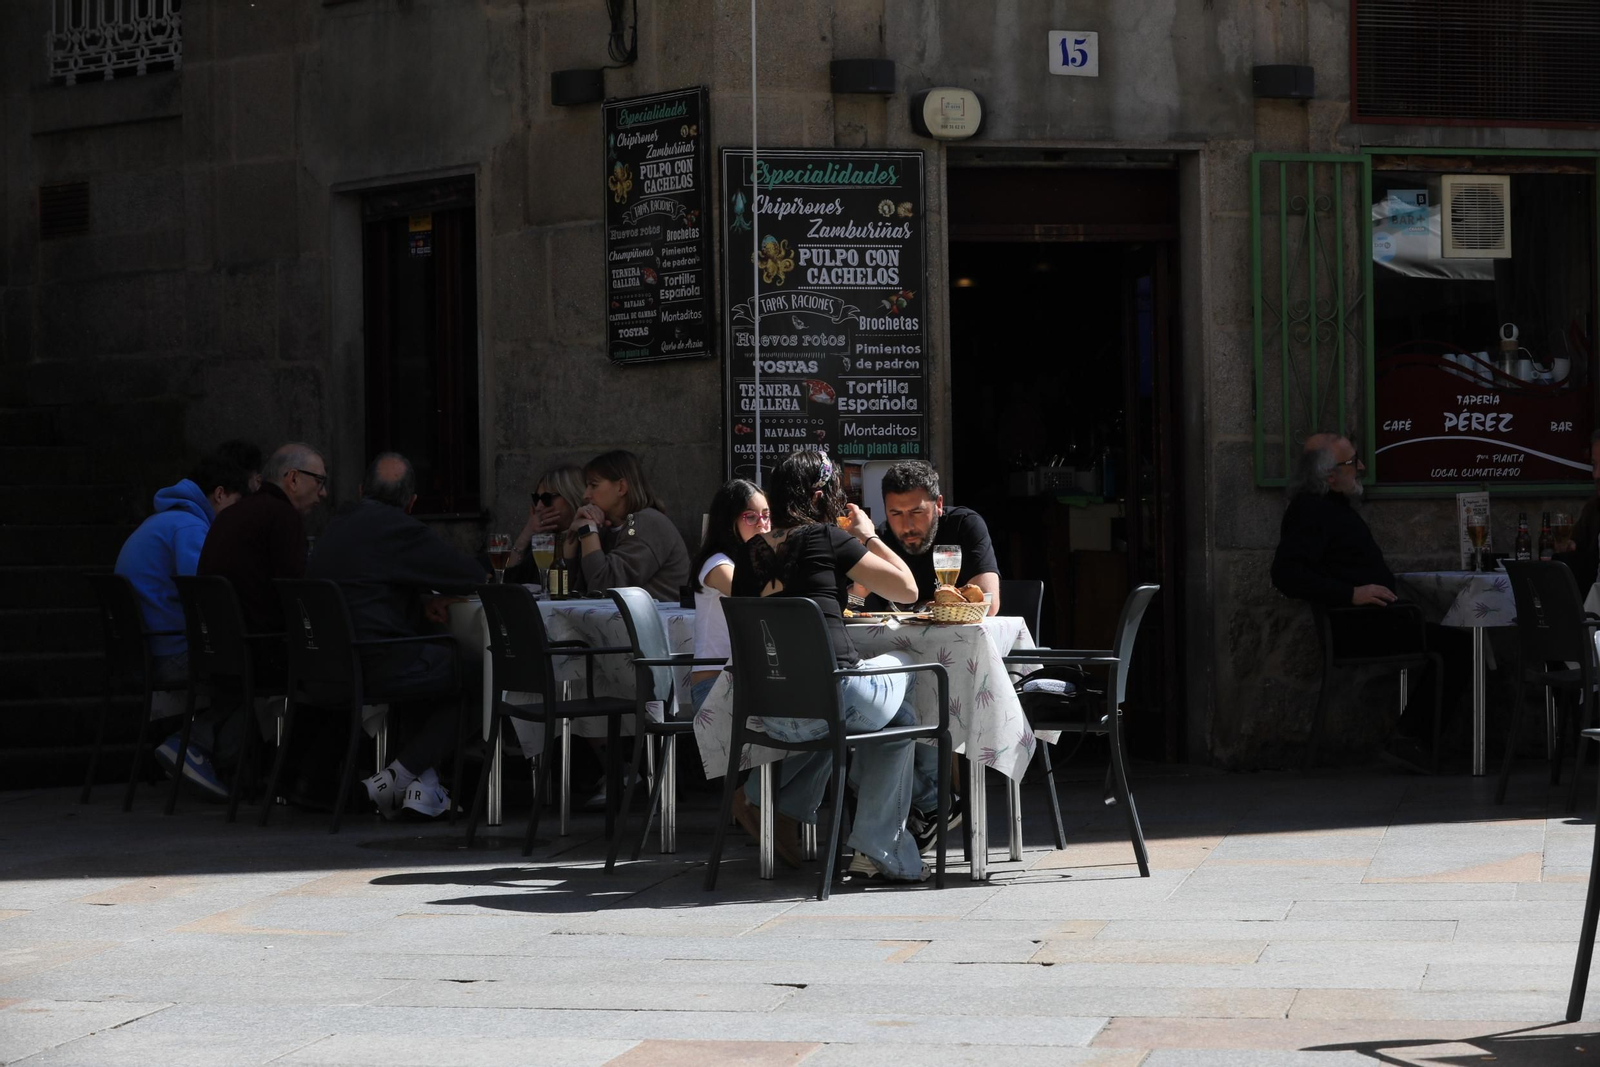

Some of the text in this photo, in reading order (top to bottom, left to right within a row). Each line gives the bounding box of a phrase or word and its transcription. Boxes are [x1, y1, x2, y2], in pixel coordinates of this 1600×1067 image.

[1059, 38, 1088, 67] 15
[619, 101, 688, 129] Especialidades
[617, 129, 659, 149] Chipirones
[646, 139, 695, 159] Zamburiñas
[640, 159, 693, 180] PULPO CON
[750, 160, 899, 190] Especialidades
[644, 174, 693, 193] CACHELOS
[752, 195, 844, 220] Chipirones
[610, 226, 660, 240] Huevos rotos
[667, 227, 700, 242] Brochetas
[807, 219, 913, 239] Zamburiñas
[609, 248, 654, 261] Champiñones
[662, 246, 697, 256] Pimientos
[662, 259, 671, 268] de
[798, 249, 900, 267] PULPO CON
[612, 267, 641, 279] TERNERA
[664, 273, 695, 286] Tortilla
[807, 268, 899, 285] CACHELOS
[613, 277, 640, 288] GALLEGA
[660, 285, 700, 300] Española
[624, 299, 645, 308] NAVAJAS
[760, 295, 835, 314] TAPAS RACIONES
[638, 310, 657, 318] GAMBAS
[661, 309, 702, 323] Montaditos
[860, 316, 919, 331] Brochetas
[618, 327, 649, 338] TOSTAS
[802, 333, 846, 346] rotos
[856, 344, 921, 355] Pimientos
[753, 361, 818, 373] TOSTAS
[856, 359, 919, 370] de padrón
[739, 384, 801, 397] TERNERA
[847, 379, 909, 394] Tortilla
[741, 398, 800, 410] GALLEGA
[838, 396, 917, 413] Española
[1457, 393, 1500, 405] TAPERÍA
[1383, 419, 1412, 431] CAFÉ
[1444, 409, 1514, 432] PÉREZ
[1550, 422, 1572, 432] BAR
[765, 429, 806, 437] NAVAJAS
[844, 423, 917, 436] Montaditos
[778, 444, 789, 452] DE
[838, 440, 919, 457] salón planta alta
[1431, 468, 1521, 478] LOCAL CLIMATIZADO
